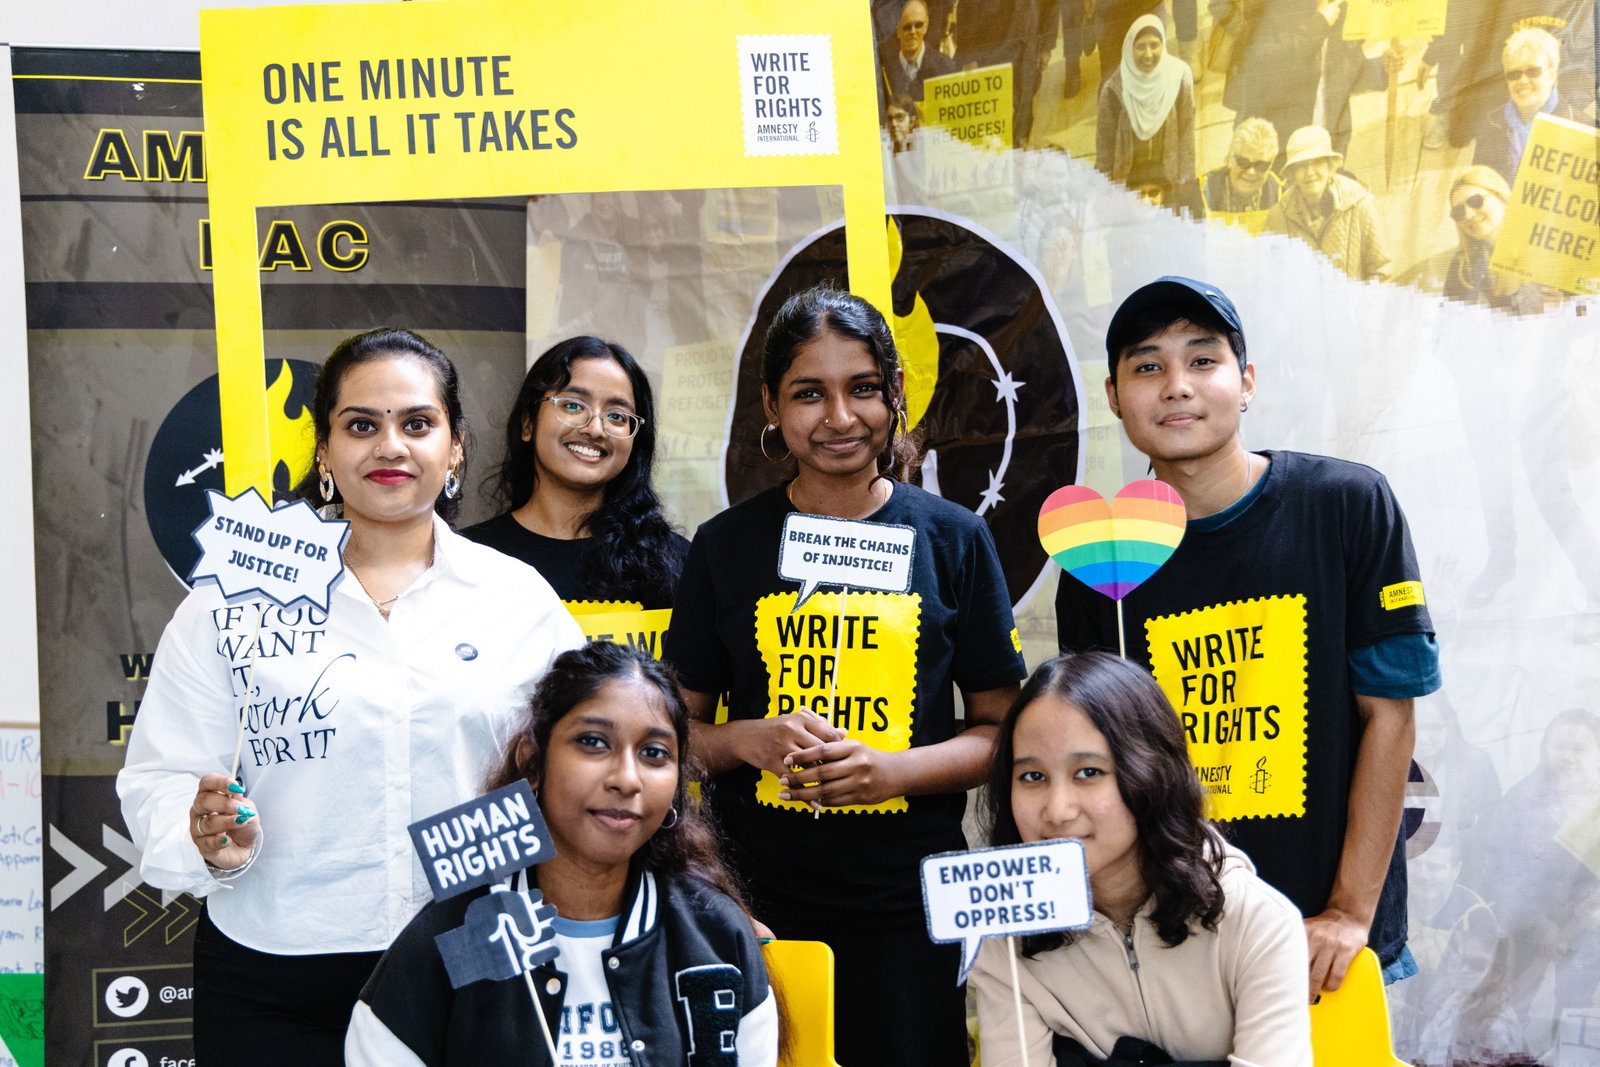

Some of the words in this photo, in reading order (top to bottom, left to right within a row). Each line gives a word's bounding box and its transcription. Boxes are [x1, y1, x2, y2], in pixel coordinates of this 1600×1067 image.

[751, 53, 810, 72] WRITE
[263, 61, 344, 104] ONE
[360, 55, 514, 100] MINUTE
[753, 75, 790, 95] FOR
[934, 79, 980, 100] PROUD
[984, 75, 1003, 91] TO
[755, 98, 822, 118] RIGHTS
[939, 99, 999, 121] PROTECT
[267, 118, 304, 160] IS
[321, 115, 390, 158] ALL
[406, 113, 440, 154] IT
[454, 108, 578, 152] TAKES
[757, 124, 798, 134] AMNESTY
[1521, 181, 1600, 227] WELCO
[198, 219, 369, 271] AC
[1529, 222, 1595, 261] HERE!
[675, 348, 717, 367] PROUD
[215, 516, 265, 543] STAND
[268, 532, 291, 549] UP
[294, 539, 328, 561] FOR
[789, 530, 831, 546] BREAK
[834, 536, 857, 548] THE
[860, 539, 909, 555] CHAINS
[228, 550, 299, 583] JUSTICE!
[803, 551, 820, 563] OF
[822, 553, 893, 572] INJUSTICE!
[210, 605, 243, 631] IF
[253, 602, 327, 627] YOU
[776, 615, 879, 649] WRITE
[217, 630, 325, 662] WANT
[1171, 624, 1264, 671] WRITE
[778, 654, 838, 690] FOR
[1181, 670, 1236, 706] FOR
[240, 653, 357, 734] work
[1181, 705, 1280, 744] RIGHTS
[249, 736, 296, 767] FOR
[301, 728, 337, 760] IT
[422, 792, 530, 858] HUMAN
[433, 823, 541, 889] RIGHTS
[939, 855, 1061, 885] EMPOWER,
[969, 880, 1034, 904] DON'T
[955, 900, 1056, 929] OPPRESS!
